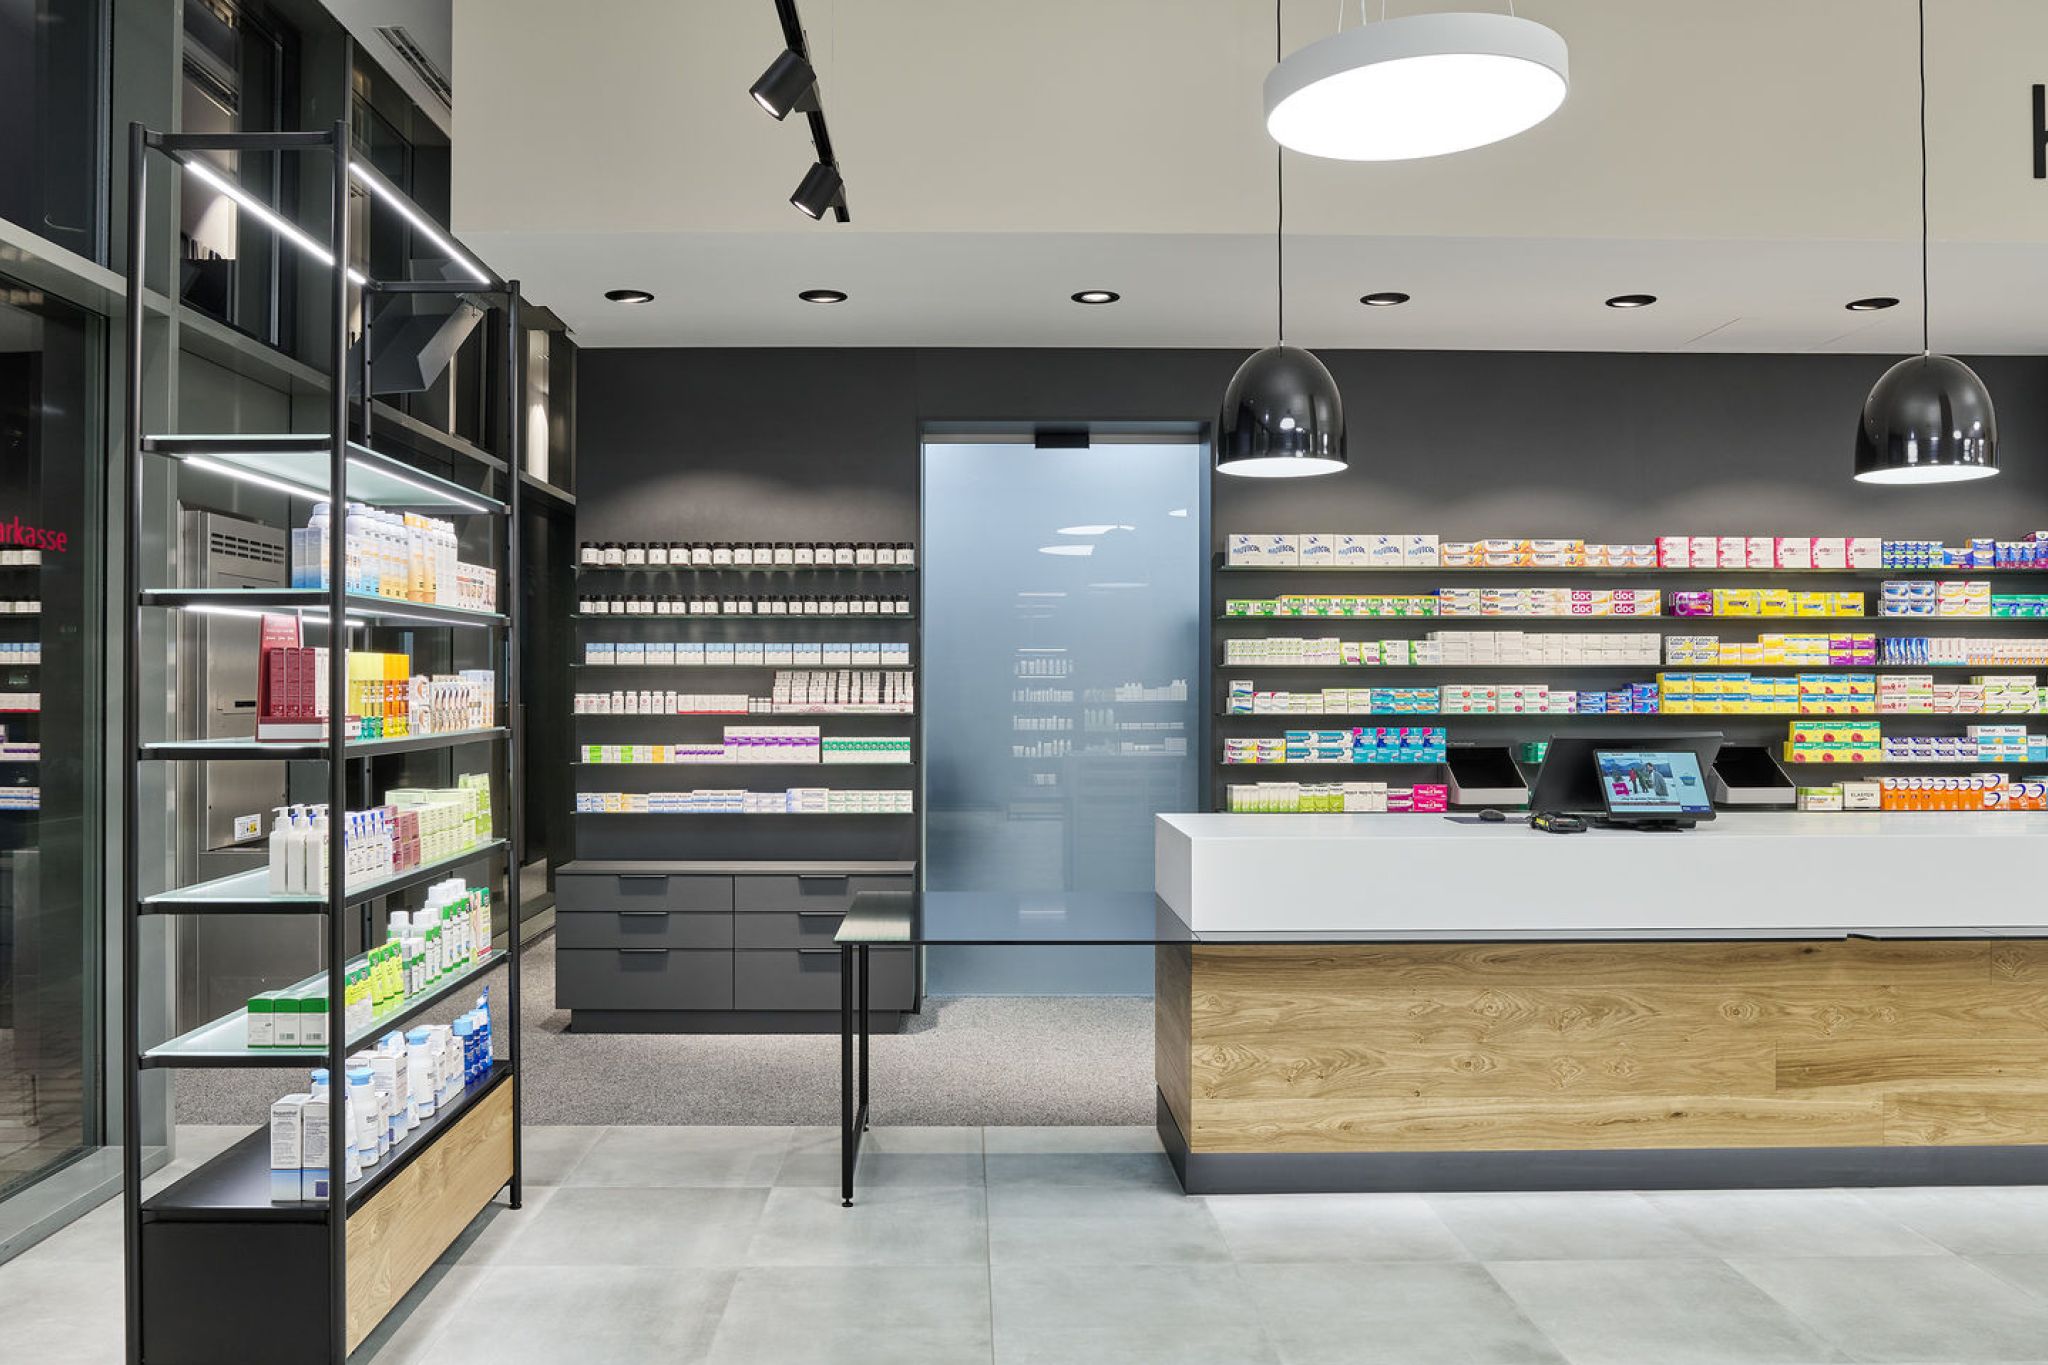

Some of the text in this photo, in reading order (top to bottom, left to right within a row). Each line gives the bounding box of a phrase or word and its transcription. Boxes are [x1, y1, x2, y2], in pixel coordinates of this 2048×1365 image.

[1572, 592, 1591, 601] doc
[1614, 591, 1634, 600] doc
[1572, 604, 1591, 613] doc
[1615, 603, 1635, 613] doc
